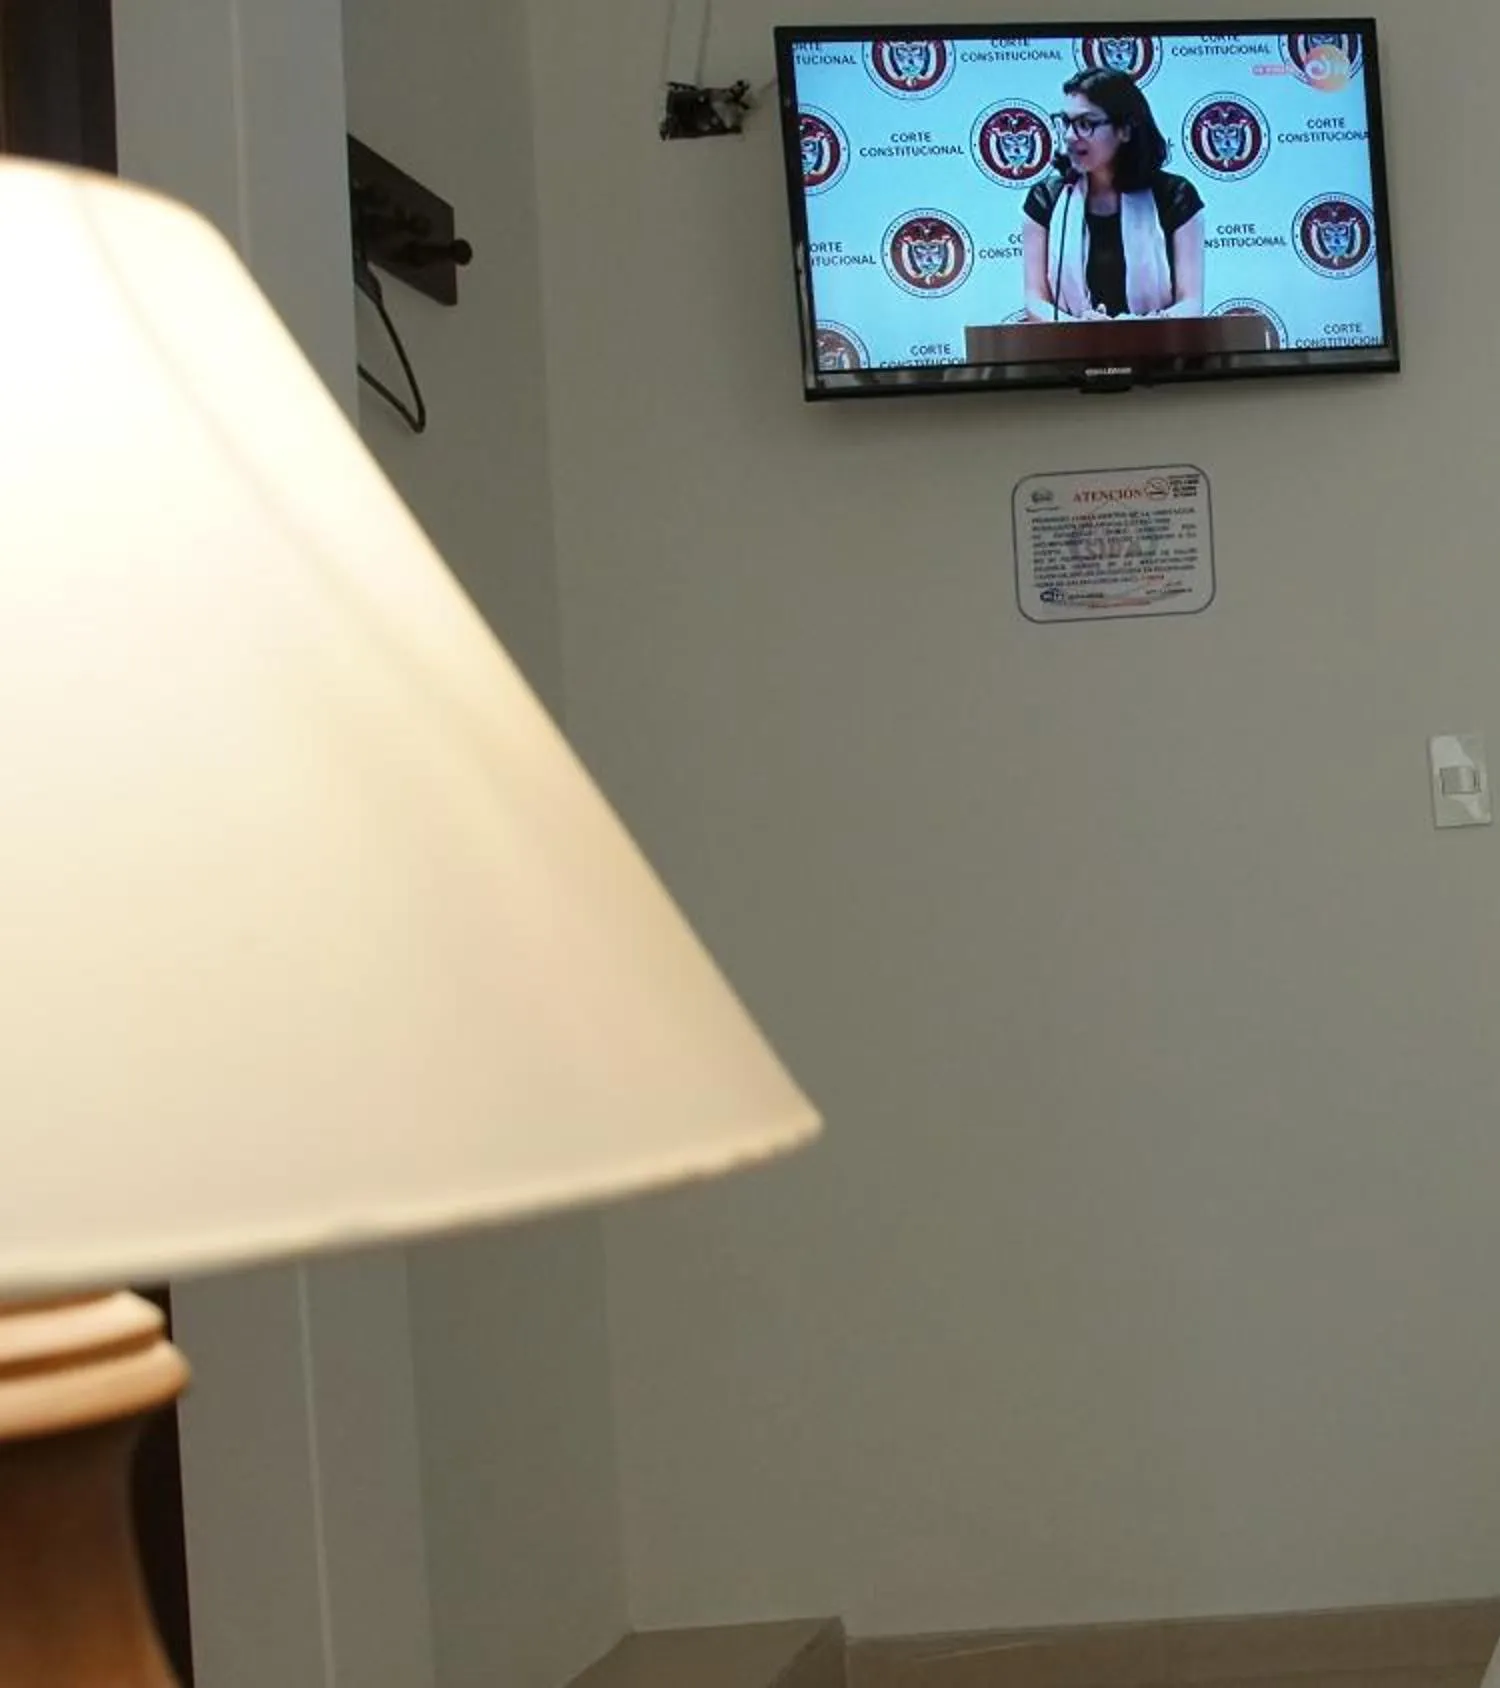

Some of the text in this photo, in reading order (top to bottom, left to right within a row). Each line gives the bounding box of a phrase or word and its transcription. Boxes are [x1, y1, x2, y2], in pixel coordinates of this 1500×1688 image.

[960, 50, 1063, 62] CONSTITUCIONAL
[1171, 44, 1271, 56] CONSTITUCIONAL
[1307, 117, 1345, 129] CORTE
[890, 131, 931, 143] CORTE
[859, 145, 965, 157] CONSTITUCIONAL
[1216, 223, 1256, 235] CORTE
[1323, 323, 1362, 335] CORTE
[910, 343, 952, 357] CORTE
